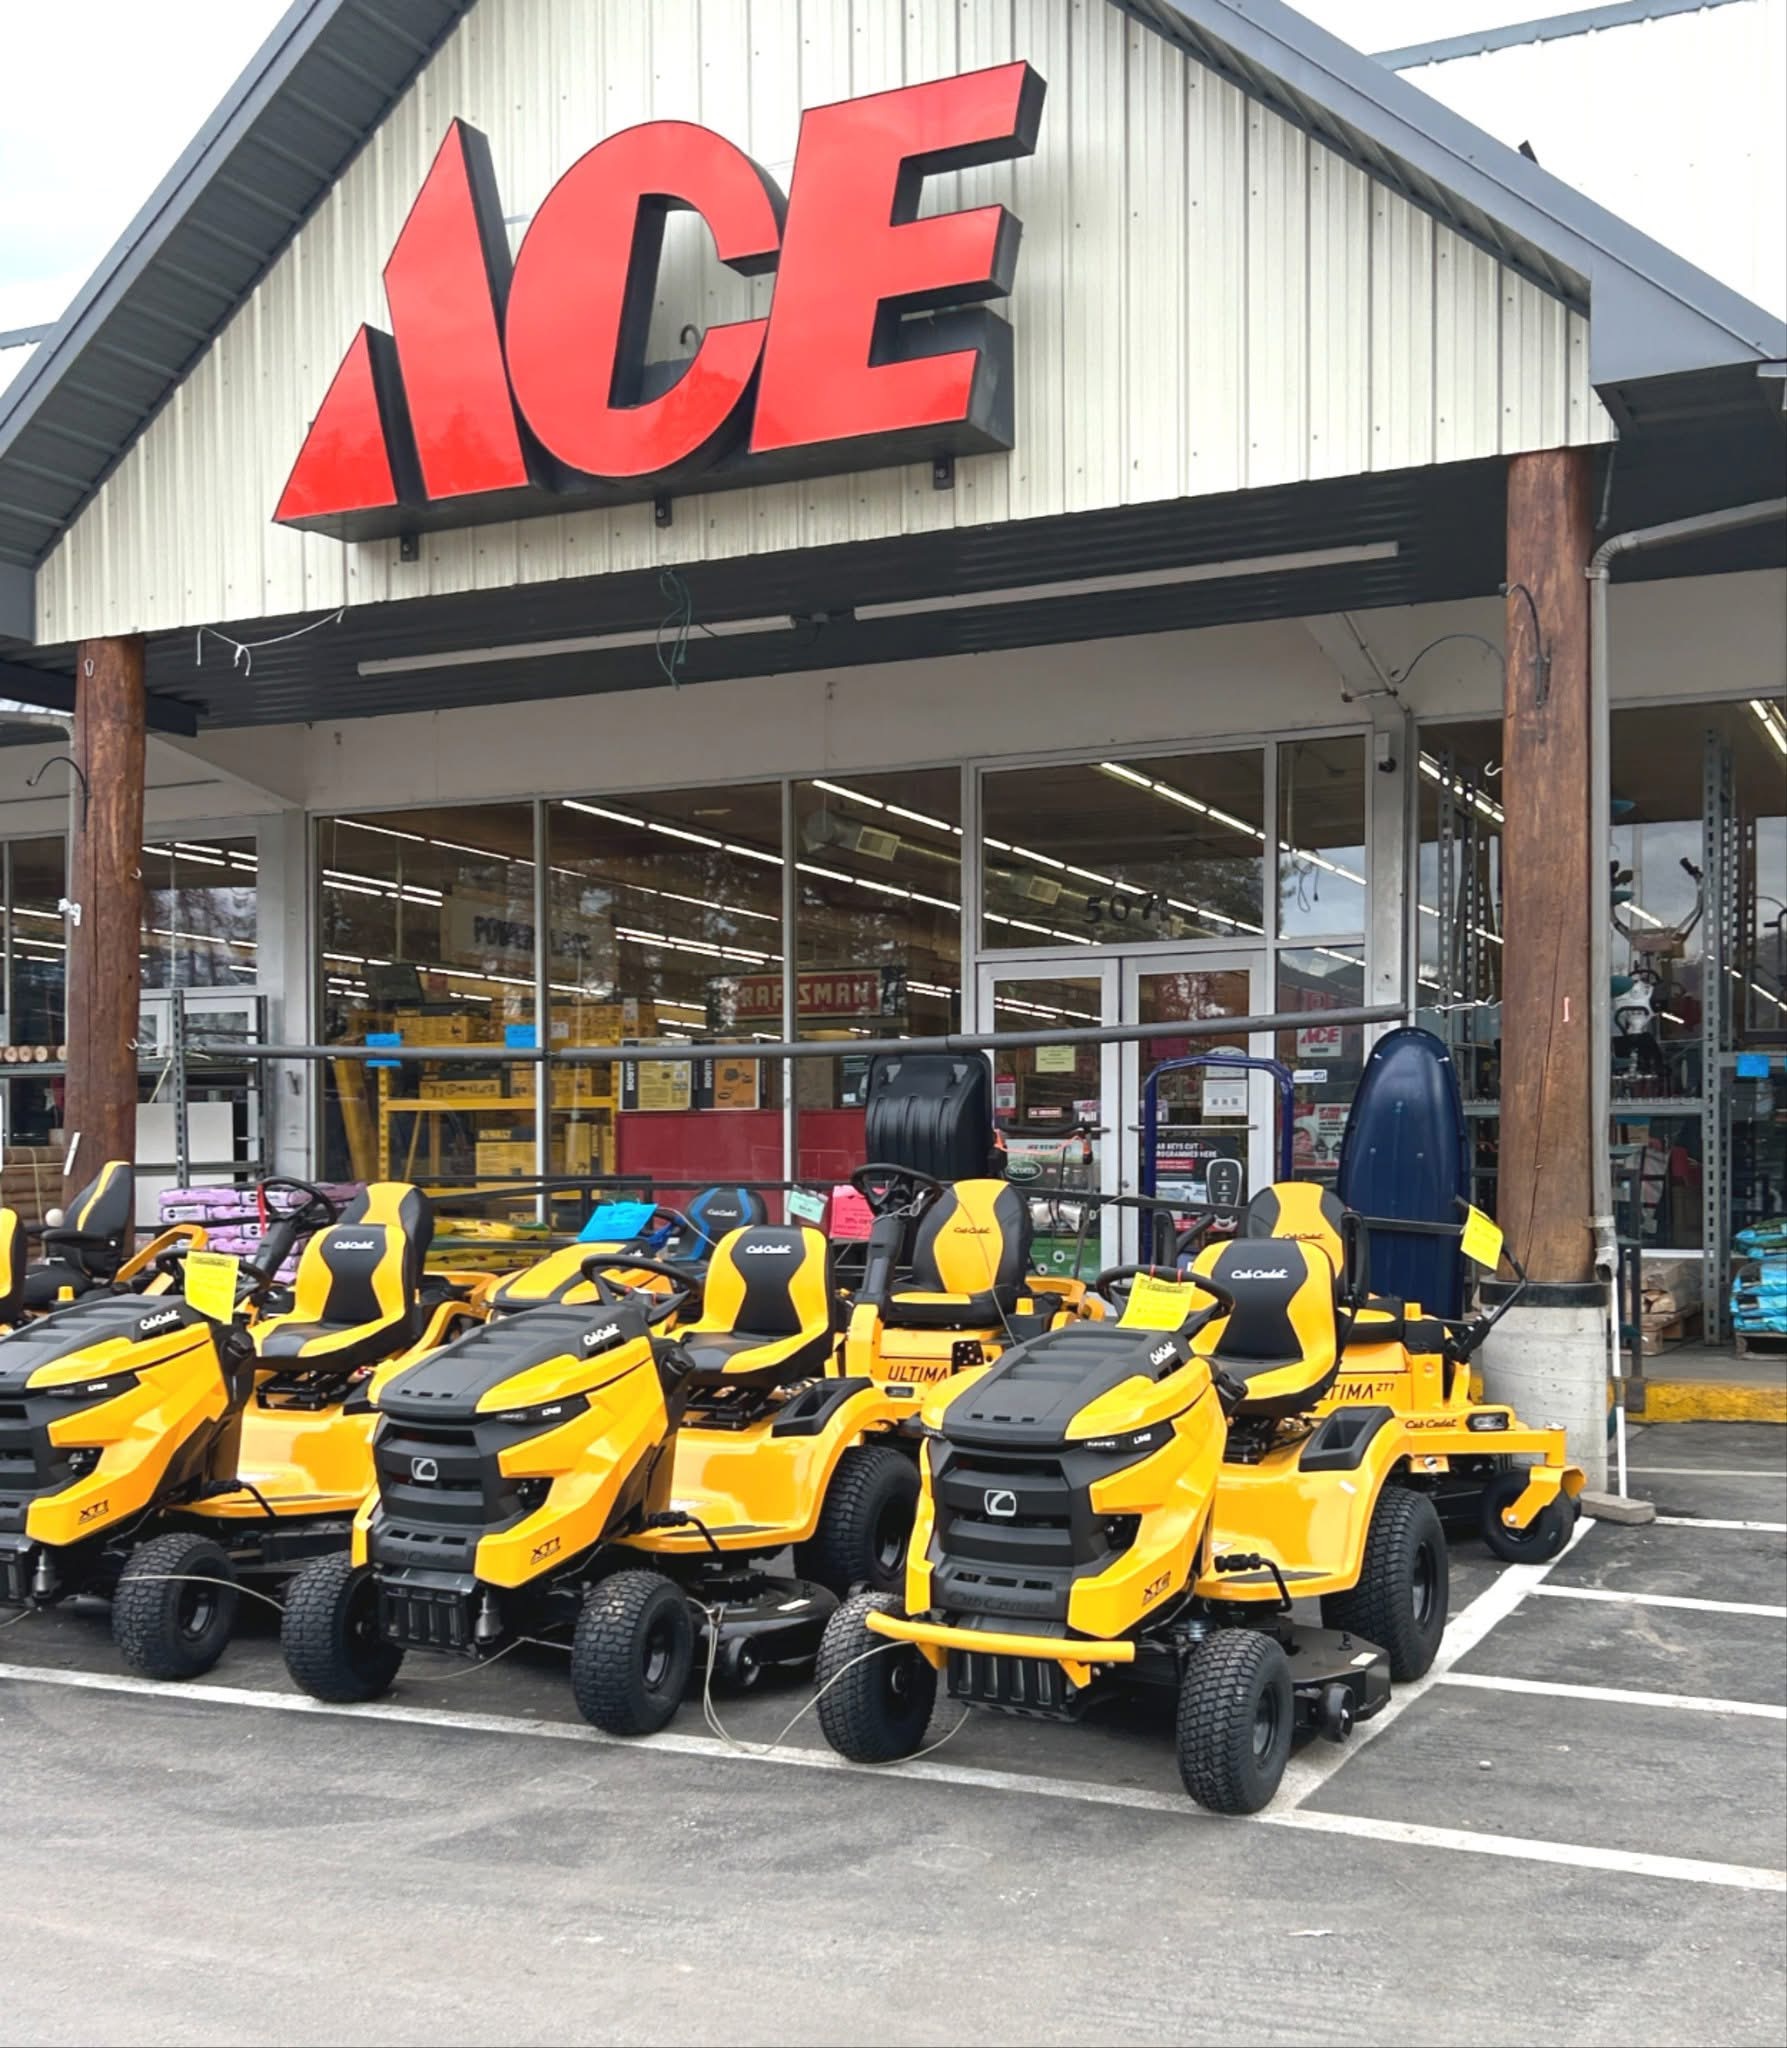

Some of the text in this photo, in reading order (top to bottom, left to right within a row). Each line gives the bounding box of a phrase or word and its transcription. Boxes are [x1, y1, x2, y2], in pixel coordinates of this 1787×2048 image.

[274, 60, 1040, 523] ACE
[1083, 893, 1154, 923] 507
[738, 981, 870, 1010] RAFSMAN
[1300, 1026, 1340, 1044] ACE
[745, 1244, 792, 1255] Cub Cadet
[1231, 1268, 1288, 1279] Cub Cadet
[887, 1365, 949, 1383] ULTIMA
[1323, 1383, 1374, 1401] TIMA
[1404, 1418, 1457, 1430] Cub Cadet
